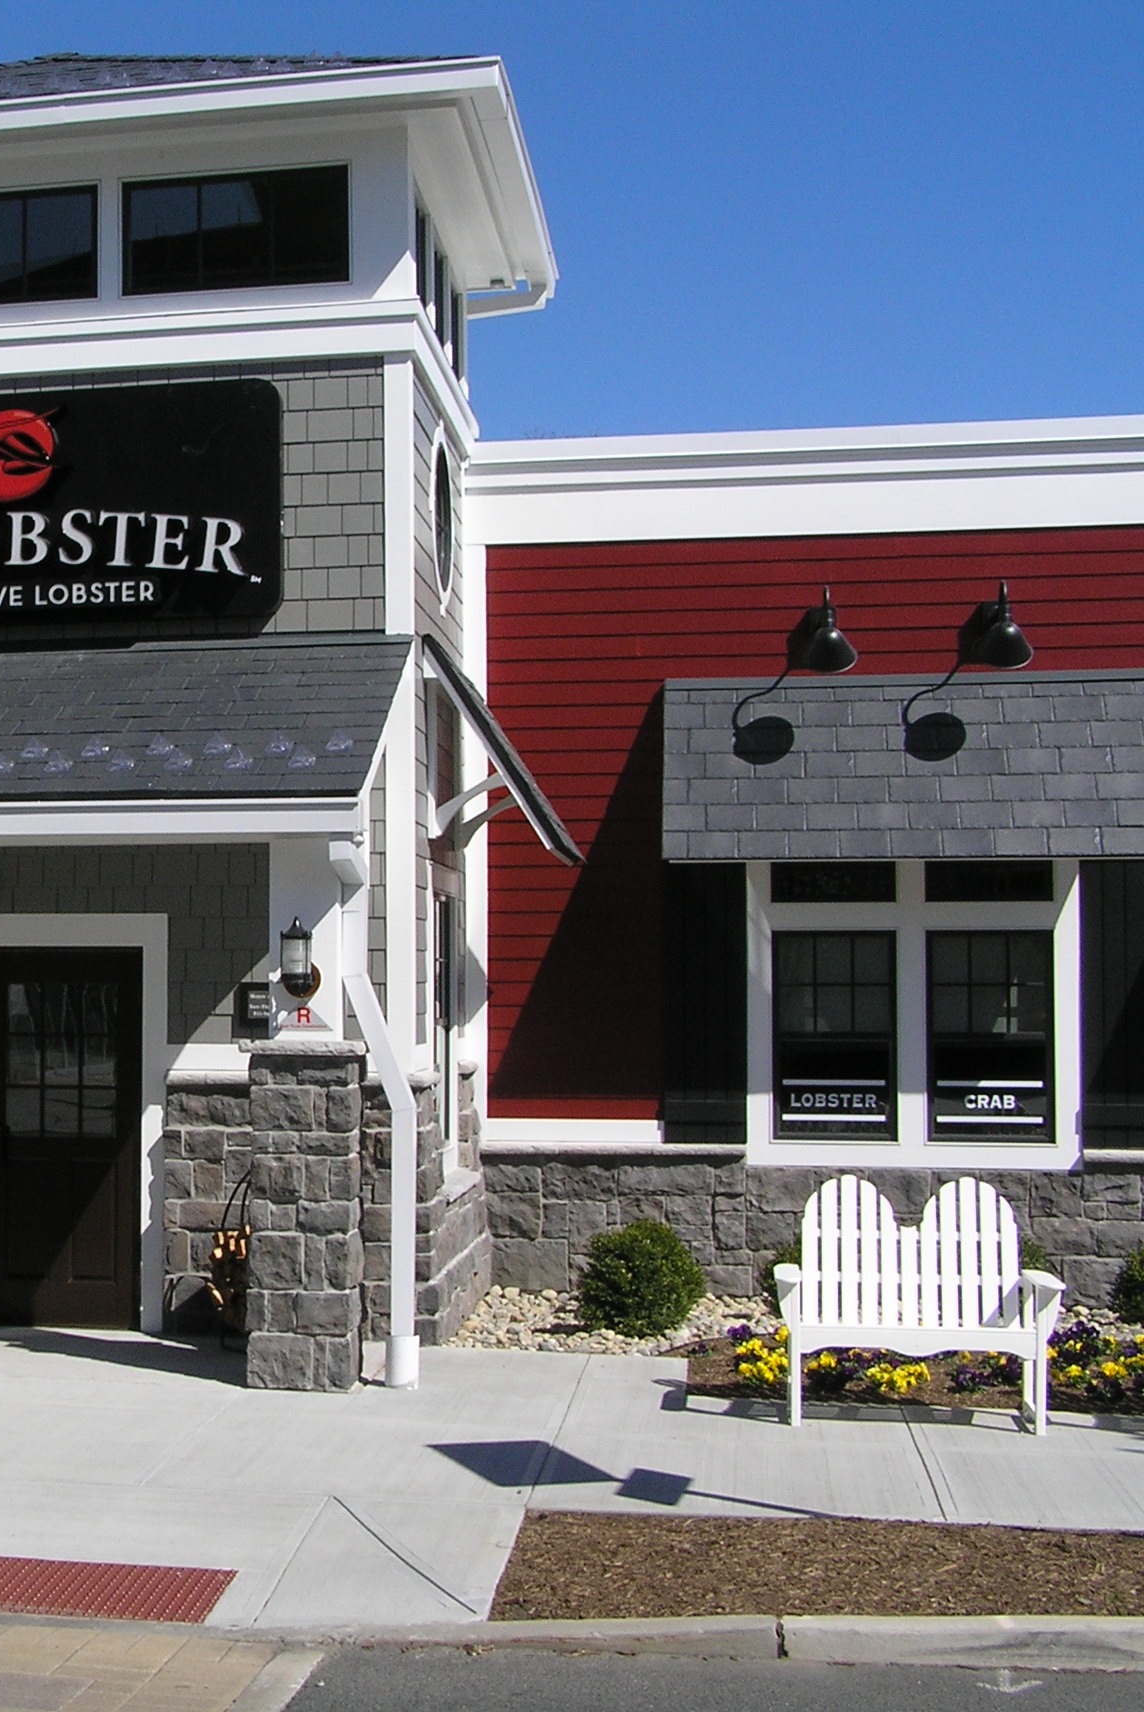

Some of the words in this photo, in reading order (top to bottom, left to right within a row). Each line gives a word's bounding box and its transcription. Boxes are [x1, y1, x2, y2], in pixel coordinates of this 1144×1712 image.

[34, 581, 155, 608] LOBSTER
[297, 1007, 311, 1024] R
[790, 1093, 877, 1108] LOBSTER
[964, 1094, 1016, 1110] CRAB
